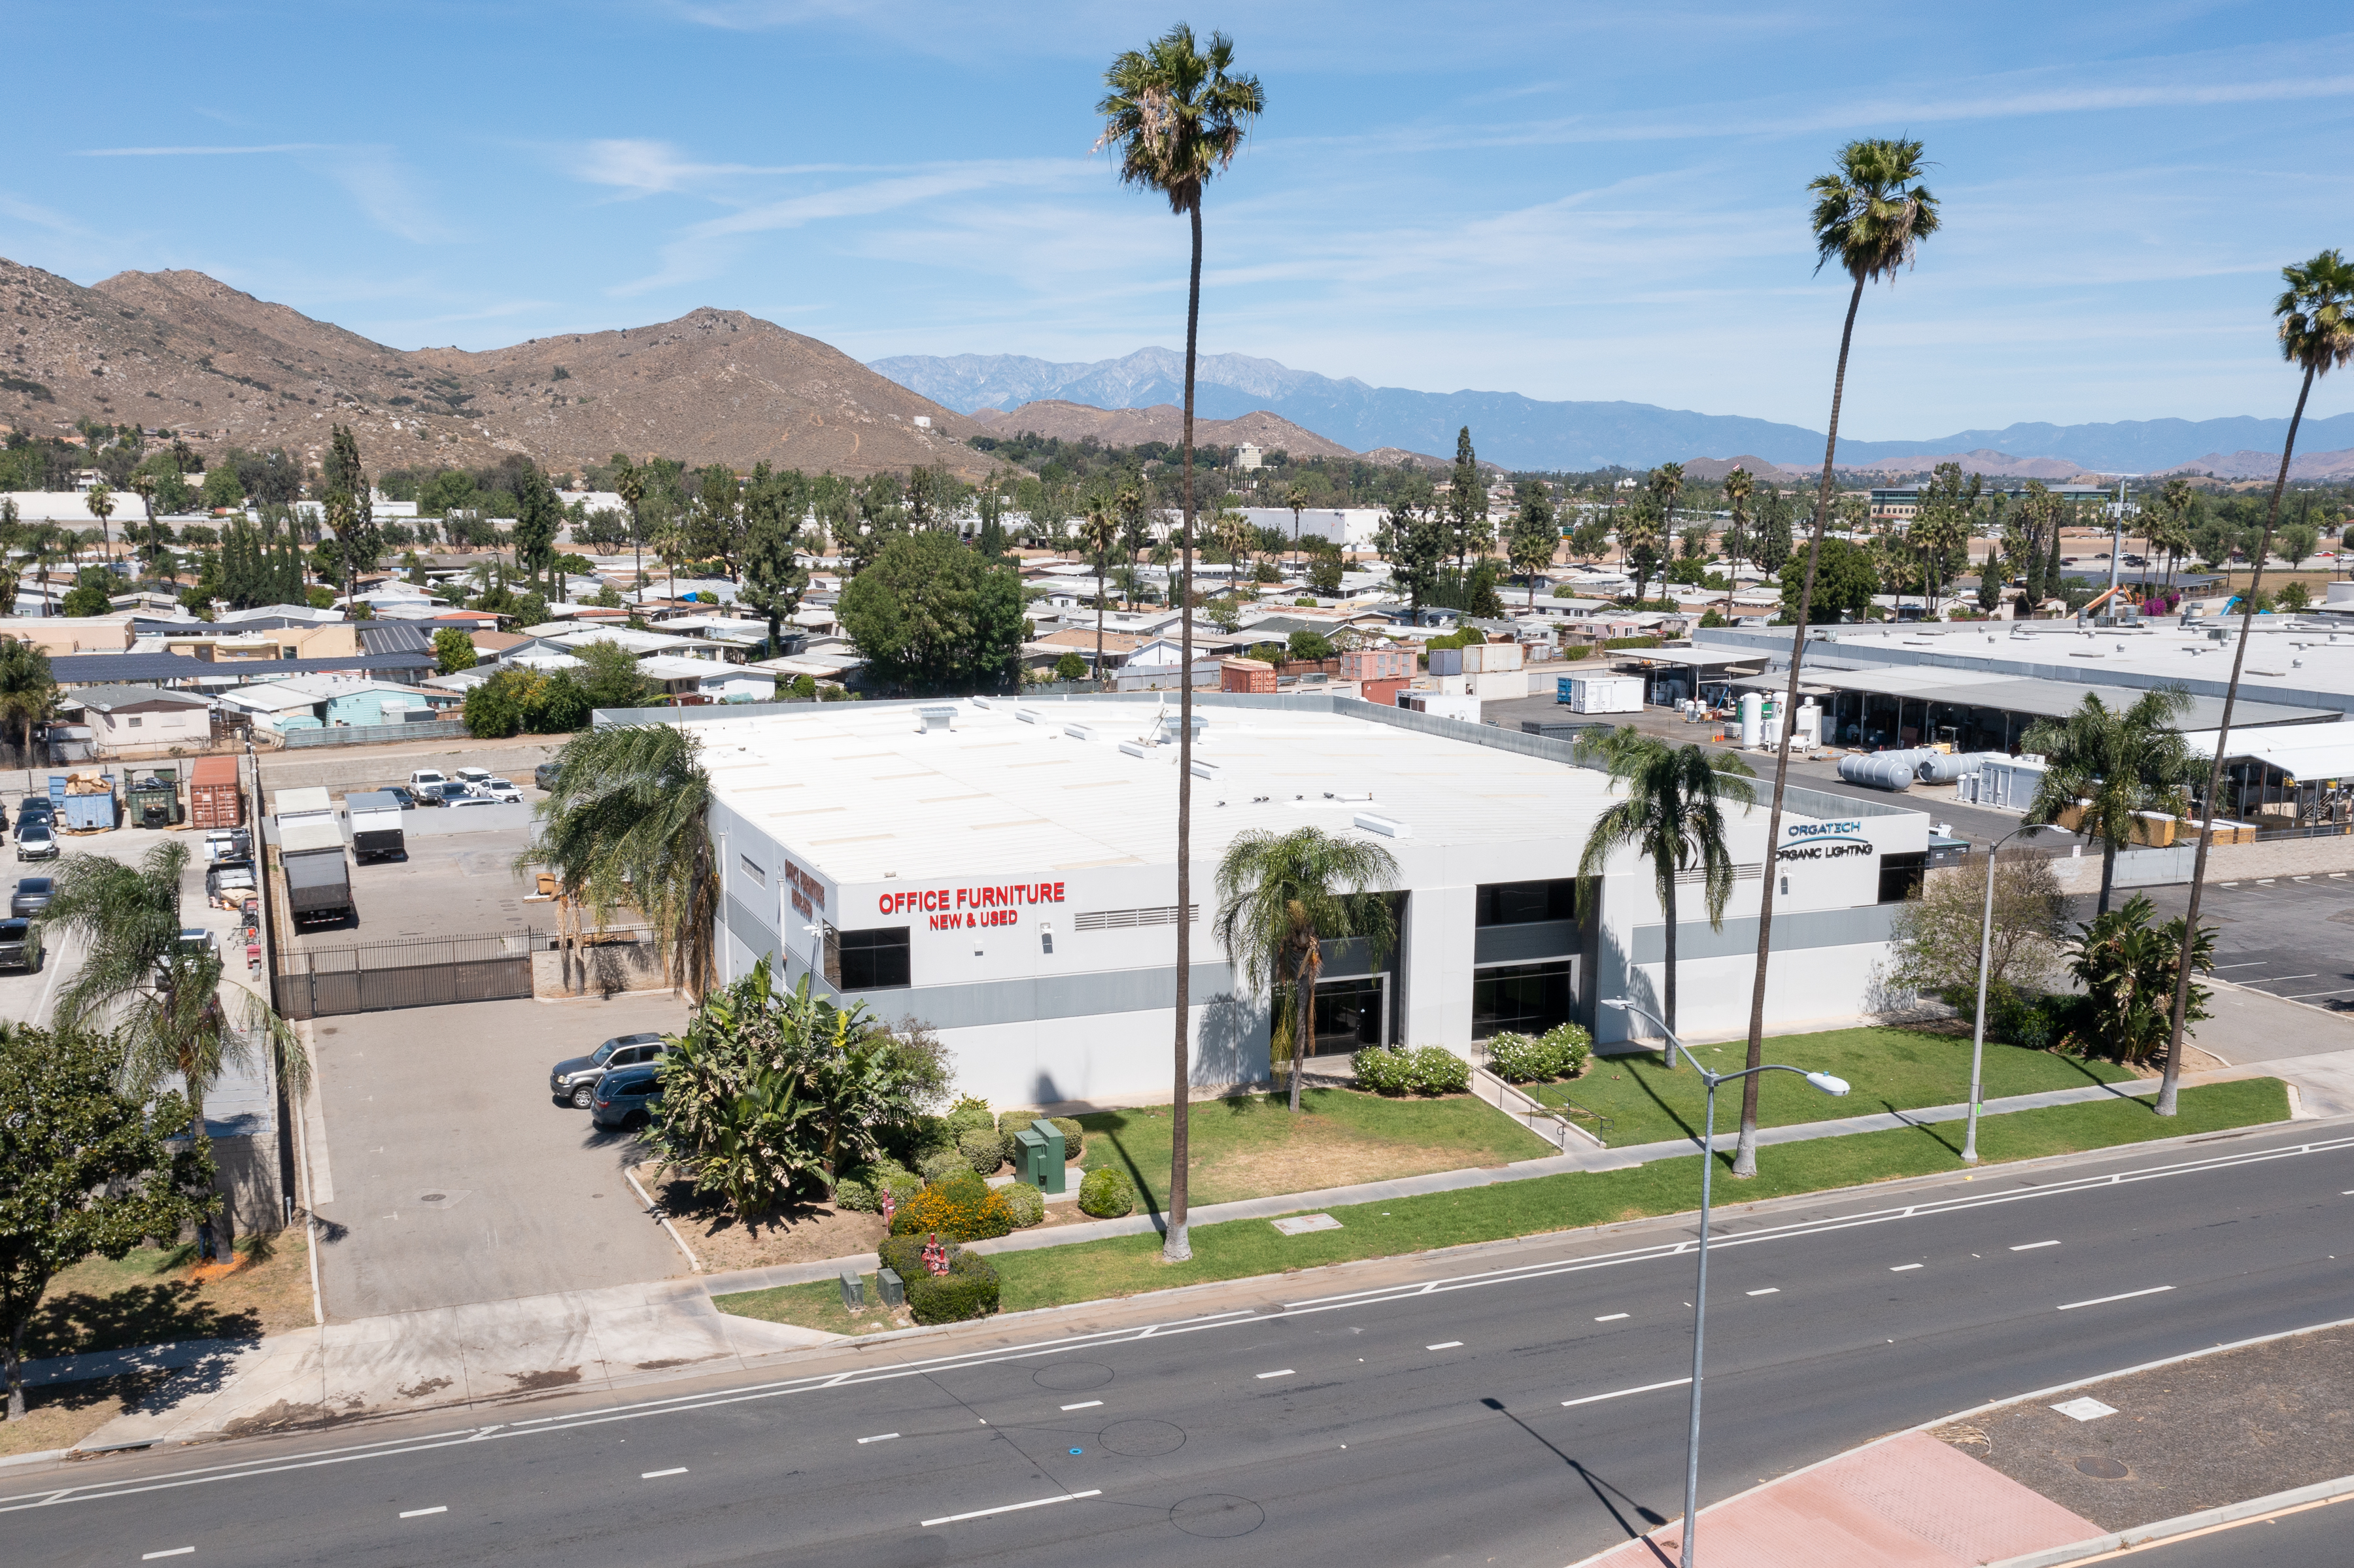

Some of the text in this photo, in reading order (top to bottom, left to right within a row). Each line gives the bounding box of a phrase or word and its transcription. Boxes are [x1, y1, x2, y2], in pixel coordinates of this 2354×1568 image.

[1788, 821, 1861, 836] ORGATECH
[1775, 844, 1873, 861] ORGANIC LIGHTING
[879, 882, 1065, 914] OFFICE FURNITURE
[930, 910, 1017, 930] NEW & USED
